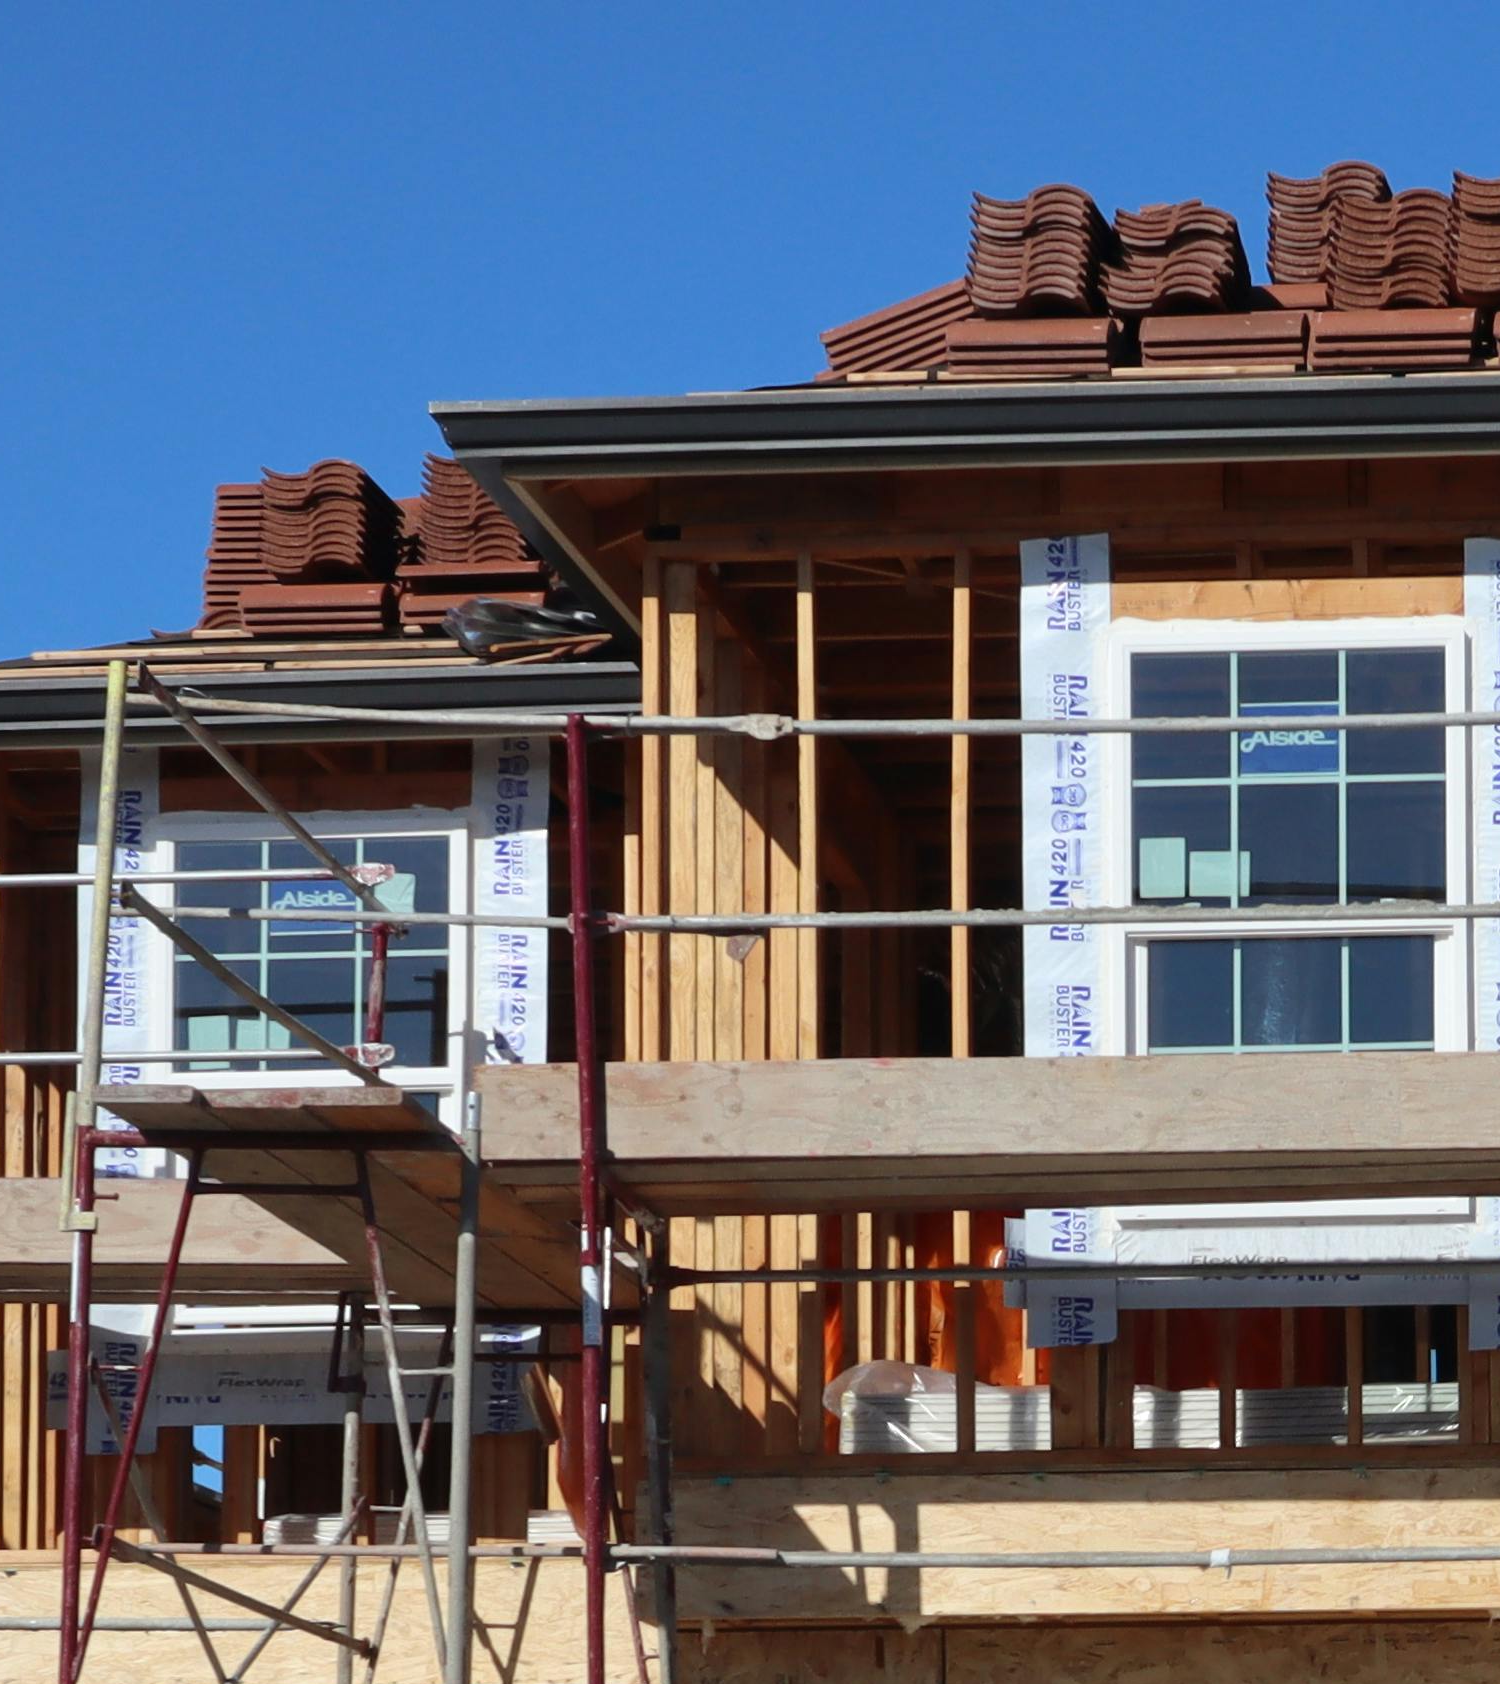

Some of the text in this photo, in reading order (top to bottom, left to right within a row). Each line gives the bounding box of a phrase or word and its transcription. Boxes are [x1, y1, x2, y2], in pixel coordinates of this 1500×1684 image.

[1053, 674, 1067, 737] BUST
[1069, 675, 1088, 777] RAI 420
[124, 790, 143, 873] RAIN 42
[494, 840, 511, 895] RAIN
[1051, 838, 1069, 942] RIN 420
[271, 889, 356, 911] Alside
[105, 934, 122, 1026] RAIN 420
[124, 972, 137, 1027] BUSTER
[1056, 986, 1070, 1047] BUSTER
[1072, 986, 1091, 1048] RAIN
[1052, 1212, 1071, 1252] RAI
[1073, 1212, 1087, 1253] BUST
[1057, 1297, 1072, 1344] BUSTE
